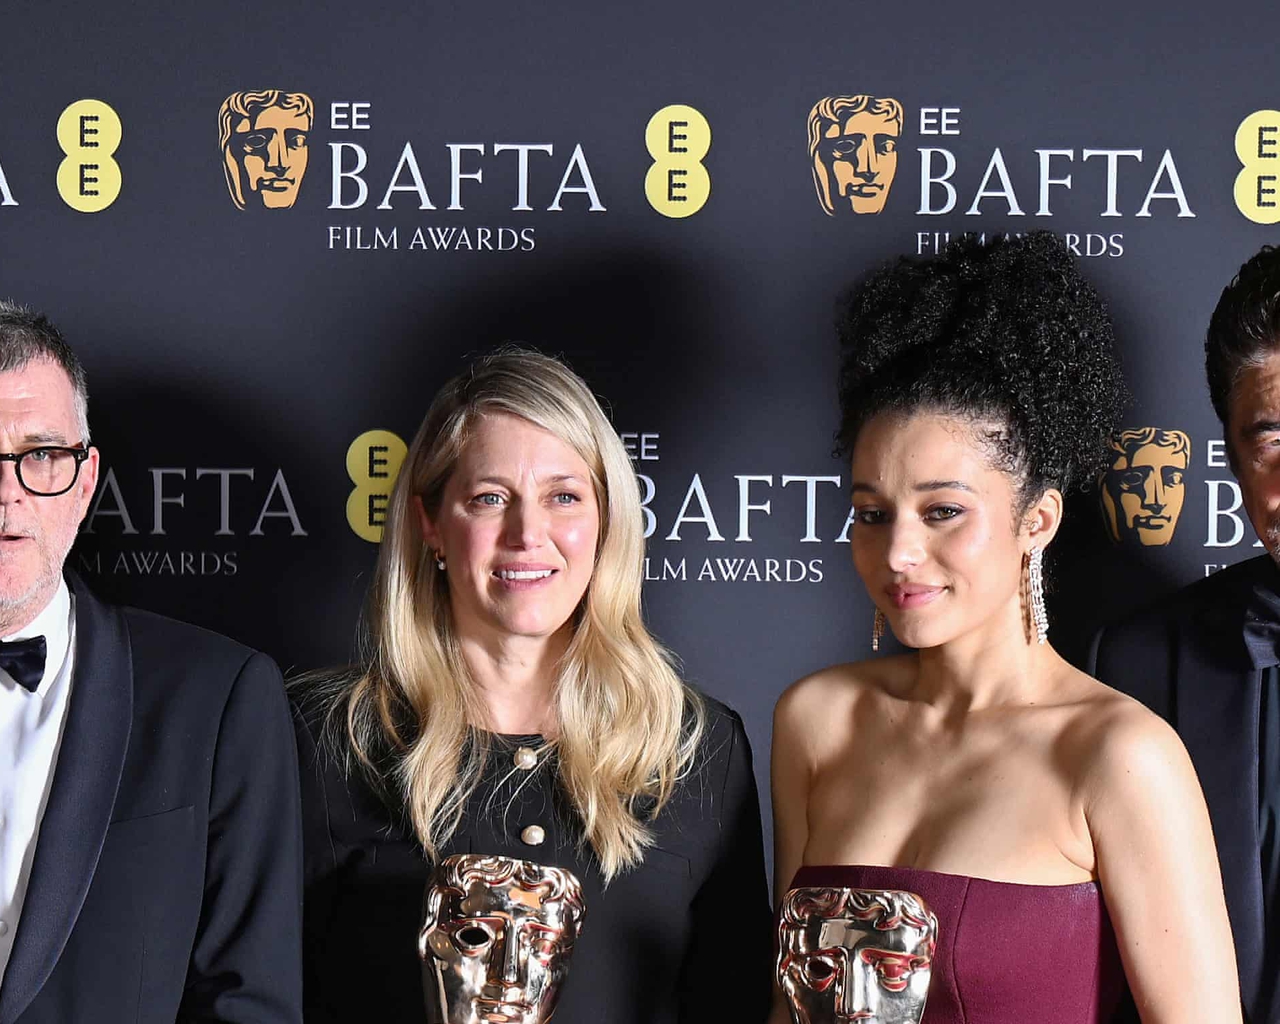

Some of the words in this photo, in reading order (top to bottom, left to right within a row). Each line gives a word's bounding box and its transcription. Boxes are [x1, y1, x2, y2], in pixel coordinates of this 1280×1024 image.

[330, 102, 371, 130] EE
[920, 107, 961, 135] EE
[326, 141, 607, 212] BAFTA
[915, 147, 1197, 218] BAFTA
[328, 226, 398, 250] FILM
[408, 226, 535, 251] AWARDS
[113, 551, 239, 576] AWARDS
[697, 557, 824, 583] AWARDS
